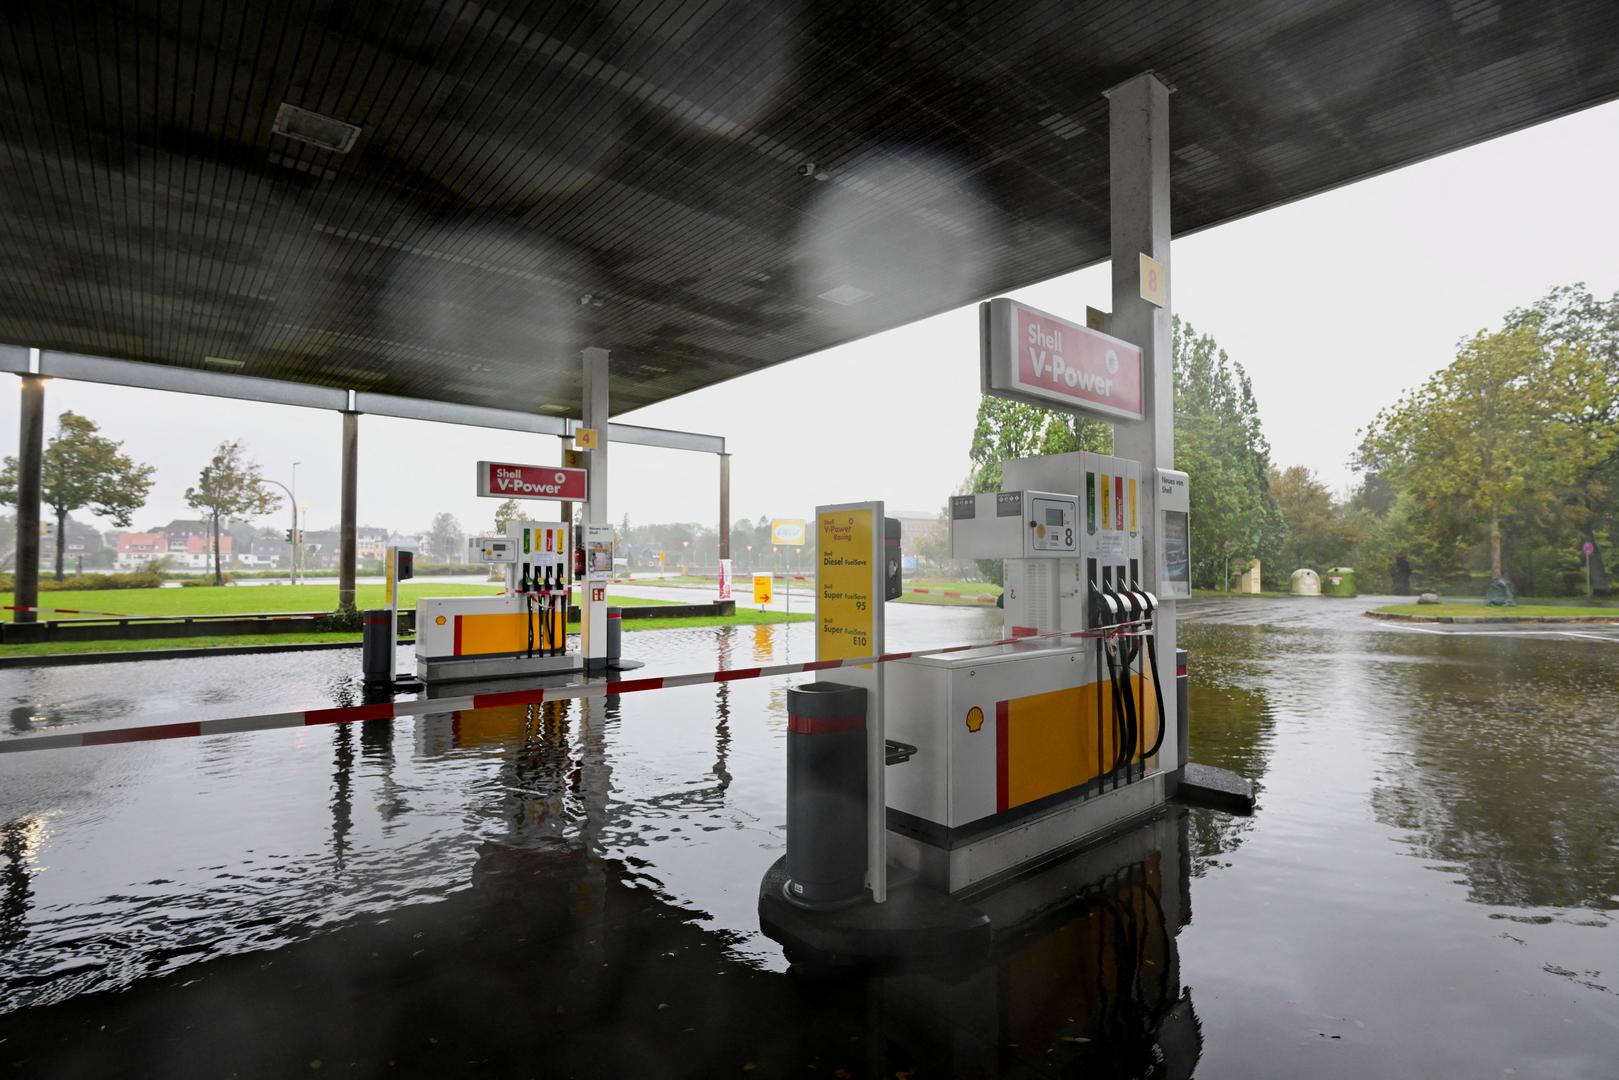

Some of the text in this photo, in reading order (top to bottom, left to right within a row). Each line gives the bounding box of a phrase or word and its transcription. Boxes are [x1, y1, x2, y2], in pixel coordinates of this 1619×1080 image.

[1148, 268, 1158, 292] 8
[1028, 323, 1062, 353] Shell
[1029, 347, 1113, 396] V-Power
[582, 433, 590, 443] 4
[569, 454, 577, 464] 3
[496, 468, 522, 479] Shell
[497, 478, 561, 494] V-Power
[1161, 486, 1173, 494] Shell
[824, 525, 852, 534] V-Power
[1065, 528, 1073, 546] 8
[824, 557, 844, 566] Diesel
[824, 591, 843, 600] Super
[856, 601, 866, 611] 95
[824, 625, 843, 635] Super
[853, 637, 867, 647] E10
